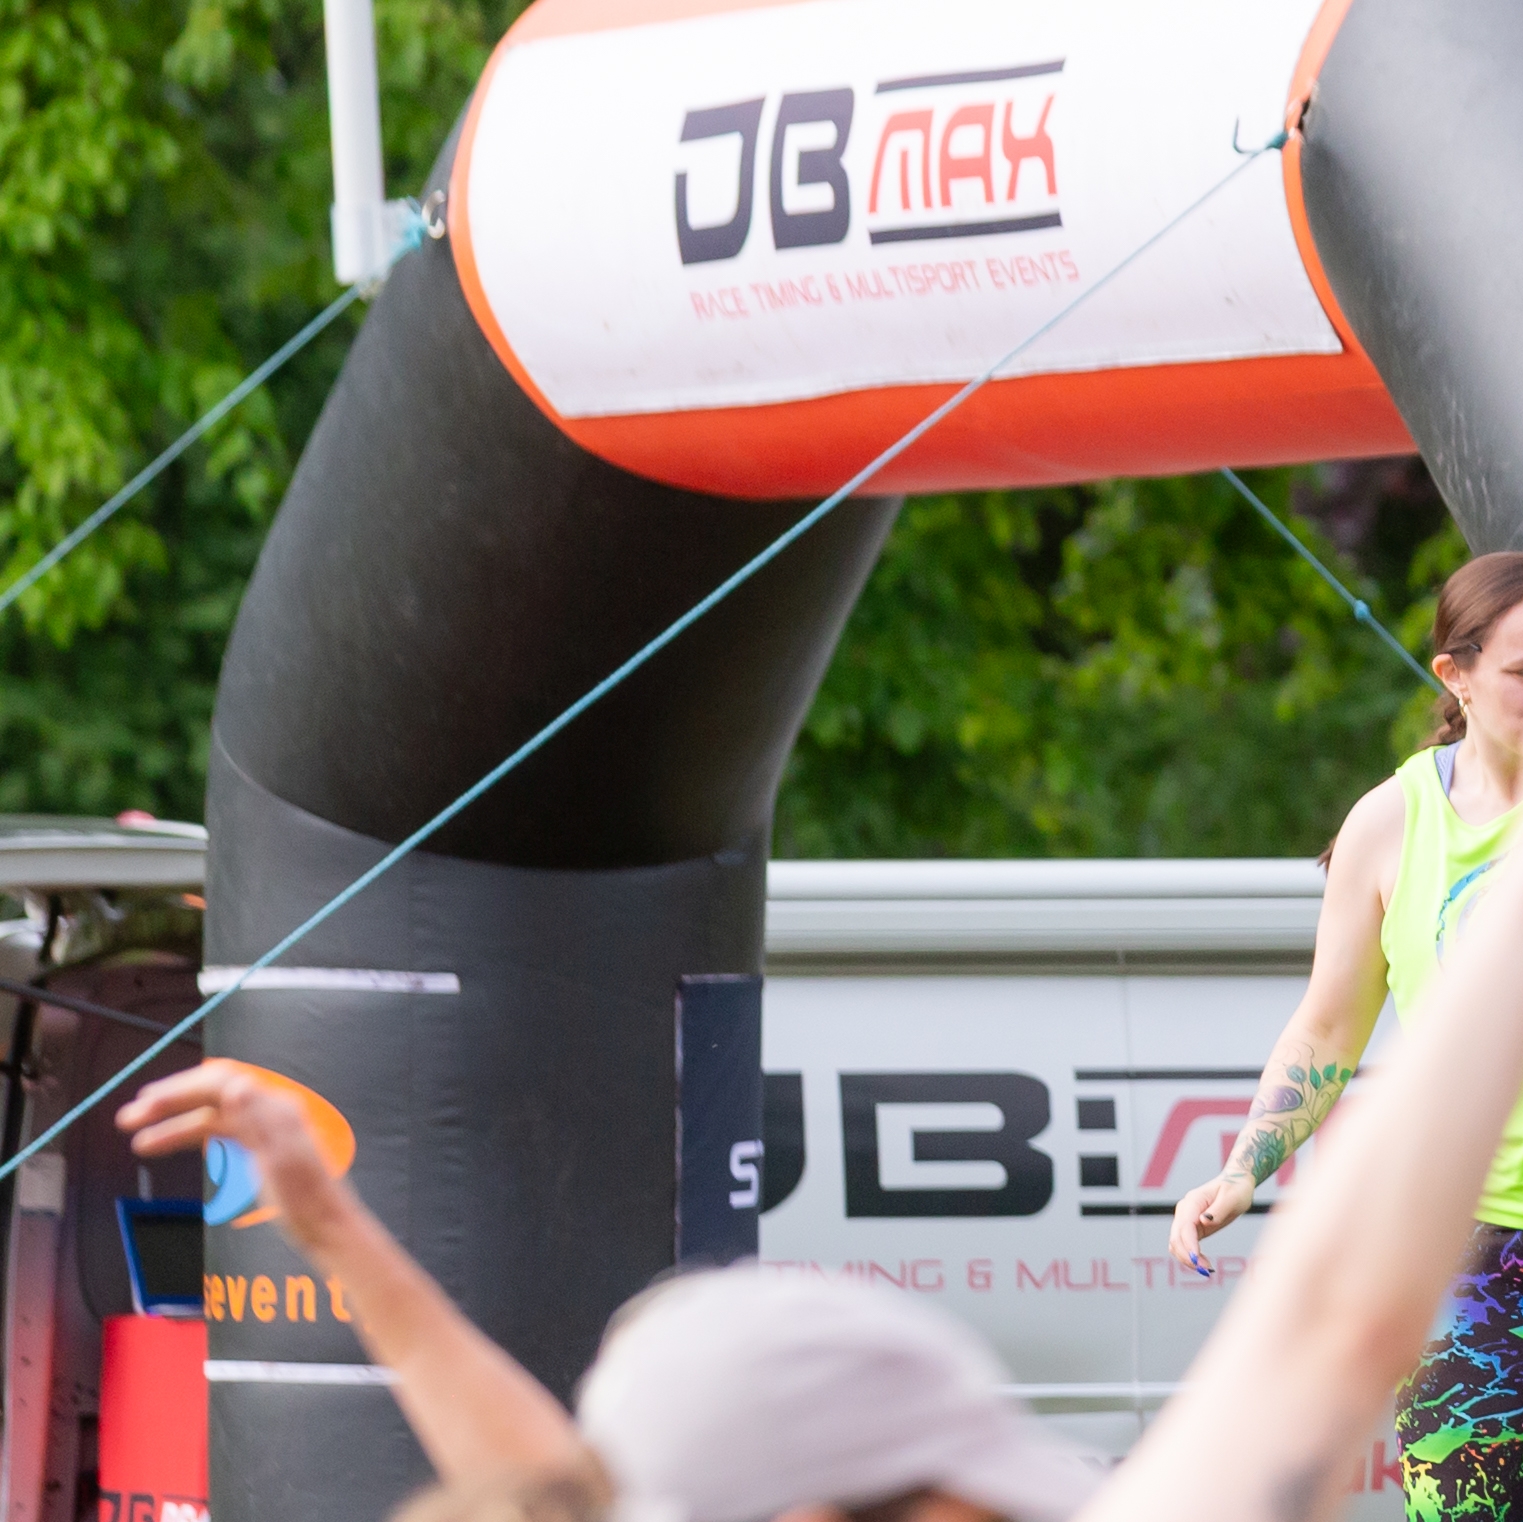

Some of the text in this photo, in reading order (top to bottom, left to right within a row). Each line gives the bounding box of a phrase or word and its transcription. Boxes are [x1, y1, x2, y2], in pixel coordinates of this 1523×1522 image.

[690, 286, 750, 322] RACE
[750, 275, 823, 311] TIMING
[843, 259, 982, 300] MULTISPORT
[985, 248, 1080, 290] EVENTS
[757, 1070, 1054, 1218] B
[1015, 1256, 1250, 1291] MULTISP
